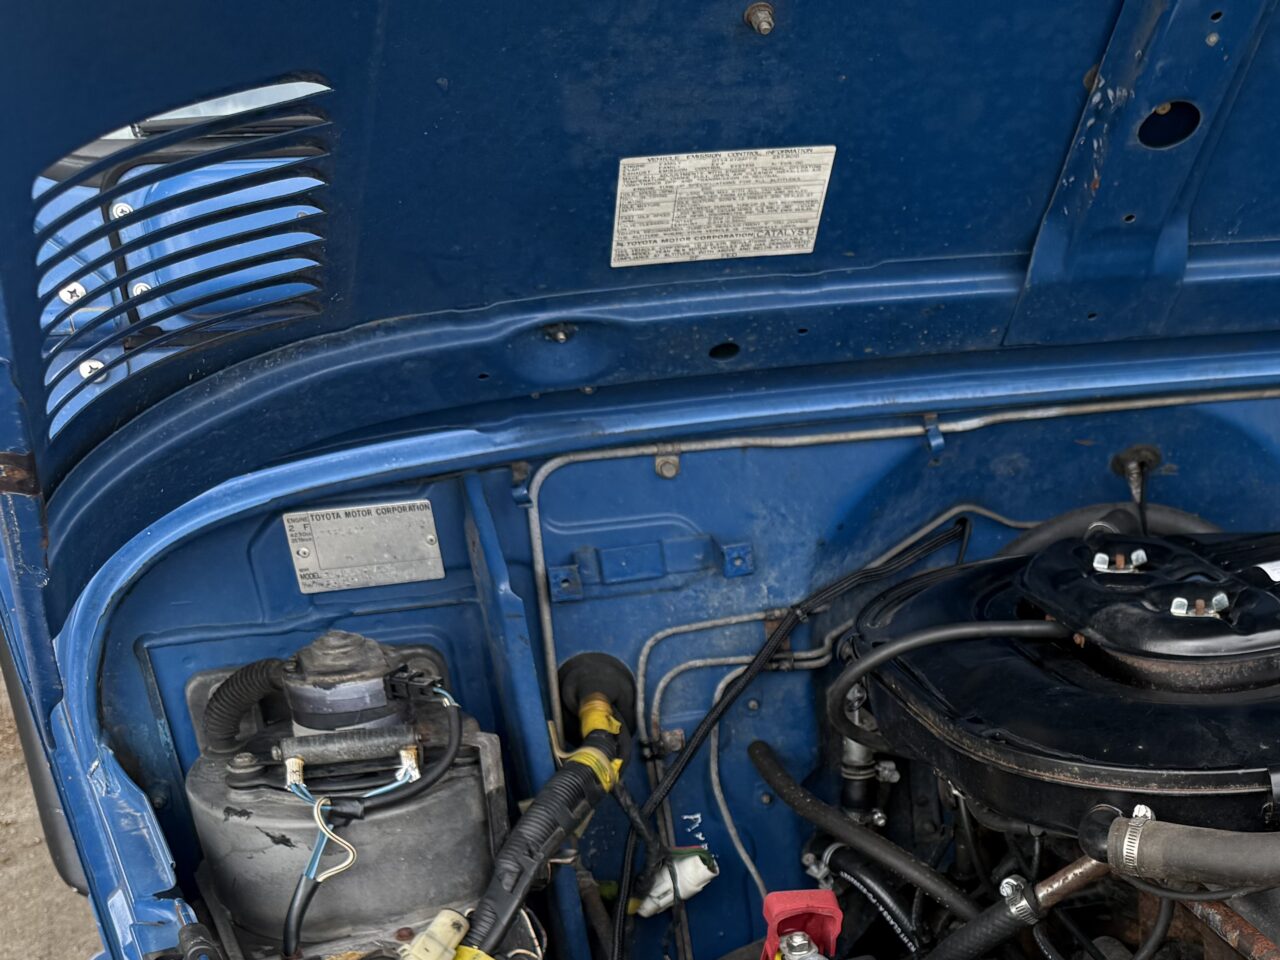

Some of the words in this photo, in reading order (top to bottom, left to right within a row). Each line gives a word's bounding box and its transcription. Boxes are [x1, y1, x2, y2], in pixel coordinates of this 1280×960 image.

[694, 232, 753, 241] CORPORATION
[757, 228, 811, 238] CATALYST
[310, 511, 342, 522] TOYOTA
[345, 509, 372, 518] MOTOR
[376, 504, 430, 515] CORPORATION
[882, 910, 901, 933] CLASS
